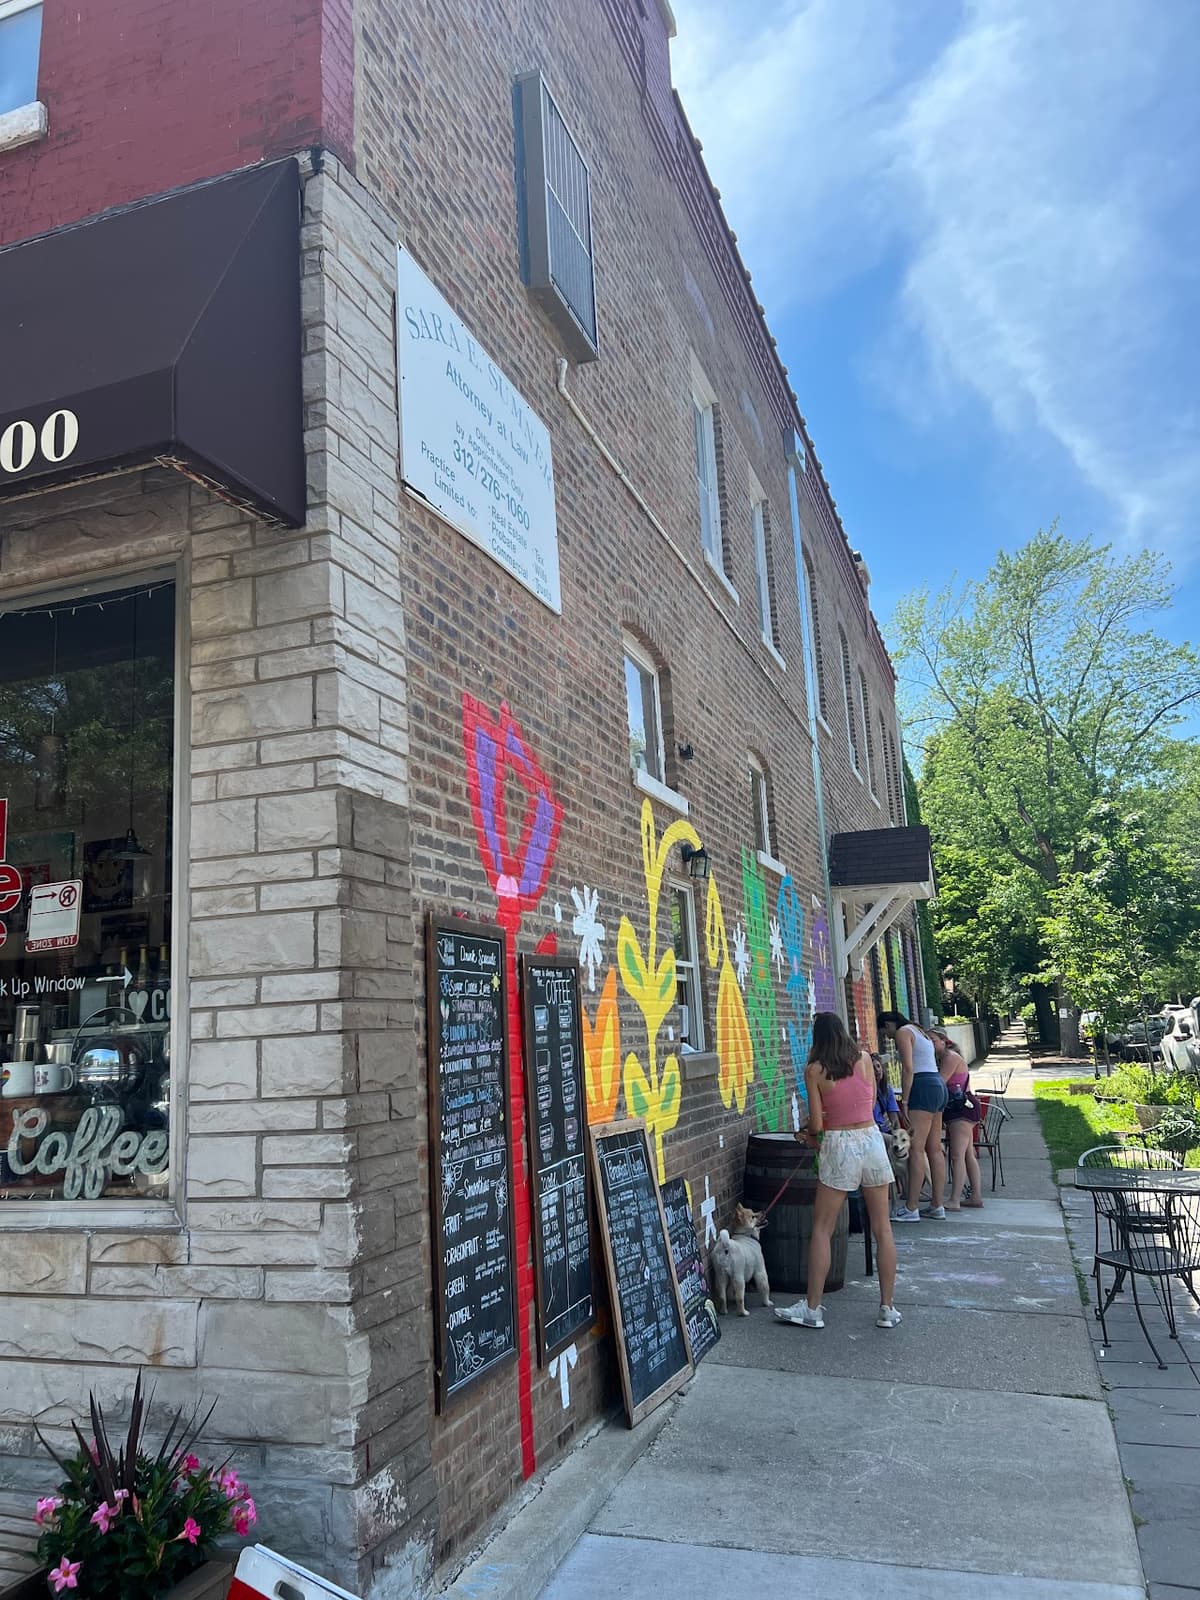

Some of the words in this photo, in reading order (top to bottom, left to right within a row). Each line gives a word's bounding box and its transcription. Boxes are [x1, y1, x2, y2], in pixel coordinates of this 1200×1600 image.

[405, 305, 461, 352] SARA
[467, 339, 483, 373] E.
[445, 360, 493, 428] Attorney
[497, 415, 506, 440] at
[510, 431, 528, 466] Law
[0, 409, 79, 473] 00
[421, 438, 455, 484] Practice
[455, 419, 464, 441] by
[468, 433, 508, 486] Appointment
[510, 476, 523, 502] Only
[475, 426, 494, 456] Office
[496, 449, 513, 476] Hours
[434, 469, 464, 509] Limited
[453, 436, 529, 532] 312/276-1060
[491, 520, 516, 554] Probate
[507, 520, 527, 551] Estate
[534, 547, 544, 567] Tax
[491, 536, 528, 581] Commercial
[11, 977, 30, 998] Up
[34, 975, 86, 994] Window
[151, 989, 170, 1021] C
[545, 978, 571, 1004] COFFEE
[8, 1105, 170, 1200] Coffee
